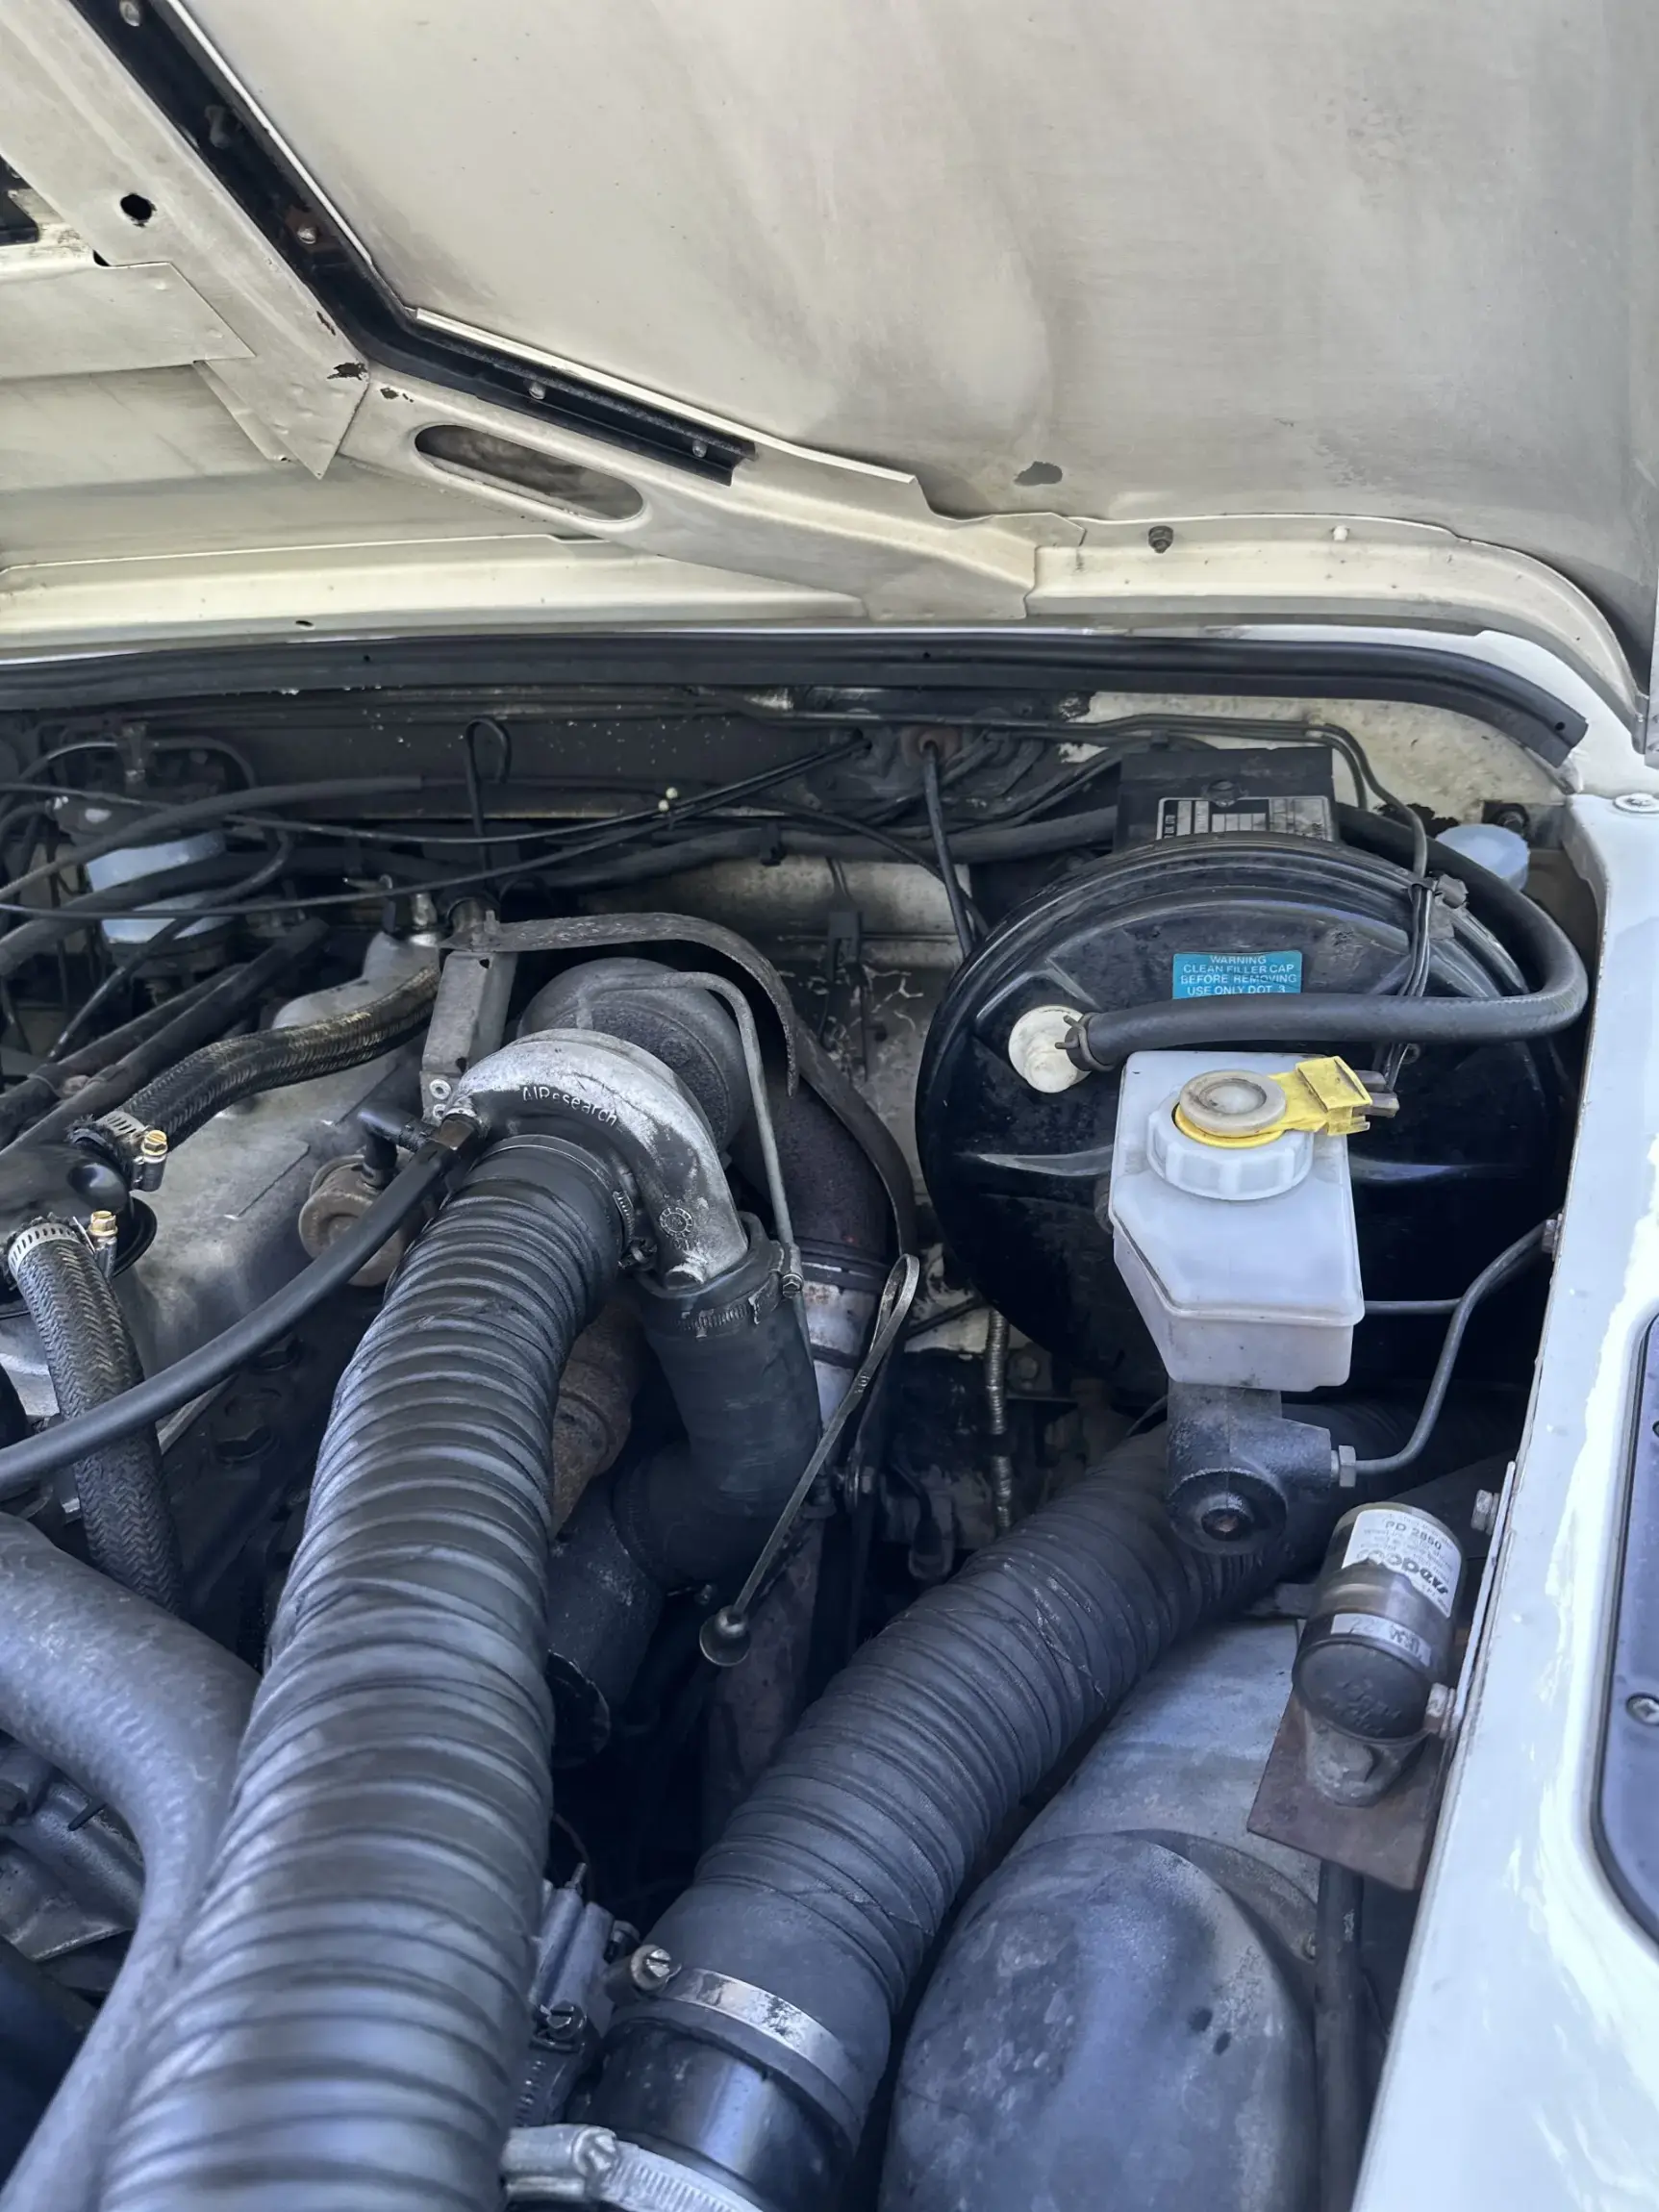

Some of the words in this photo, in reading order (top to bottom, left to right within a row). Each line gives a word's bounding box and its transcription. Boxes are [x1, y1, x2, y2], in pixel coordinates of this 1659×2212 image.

[1210, 955, 1267, 965] WARNING
[1183, 964, 1223, 973] CLEAN
[1226, 965, 1267, 974] FILLER
[1269, 964, 1295, 973] CAP
[1180, 974, 1228, 985] BEFORE
[1233, 973, 1297, 984] REMOVING
[1187, 986, 1211, 996] USE
[1214, 985, 1244, 995] ONLY
[1247, 985, 1272, 994] DOT
